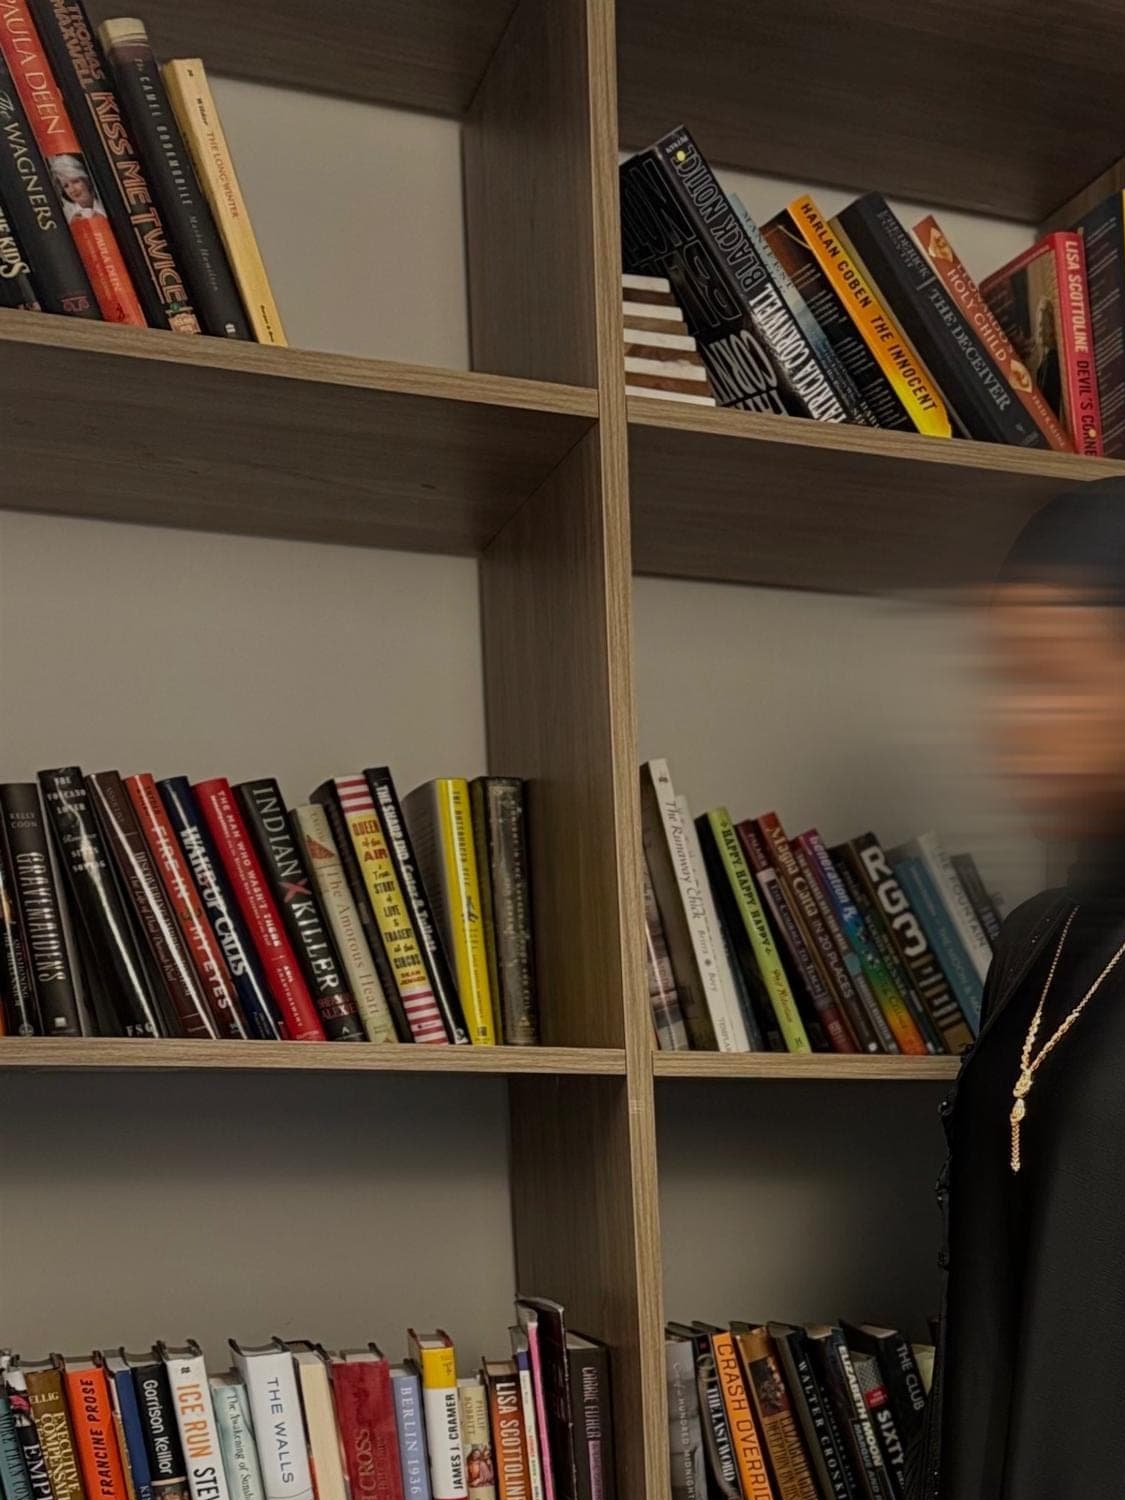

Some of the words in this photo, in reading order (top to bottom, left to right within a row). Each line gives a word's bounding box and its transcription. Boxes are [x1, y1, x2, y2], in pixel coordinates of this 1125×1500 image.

[65, 3, 103, 81] THOMAS
[0, 0, 39, 66] AULA
[24, 68, 64, 138] DEEN
[88, 85, 133, 157] KISS
[205, 131, 218, 151] THE
[2, 122, 57, 233] WAGNERS
[115, 157, 150, 209] ME
[211, 151, 227, 181] LONG
[220, 180, 239, 219] WINTER
[0, 234, 31, 279] KIDS
[132, 207, 188, 306] TWICE
[709, 216, 768, 291] BLACK
[1065, 240, 1079, 269] LISA
[745, 282, 812, 369] CORNWELL
[800, 202, 841, 258] HARLAN
[836, 259, 872, 308] COBEN
[869, 314, 893, 342] THE
[886, 342, 937, 414] INNOCENT
[945, 268, 976, 310] HOLY
[972, 311, 1007, 362] CHILD
[1067, 274, 1088, 353] SCOTTOLINE
[926, 287, 958, 328] THE
[950, 324, 1013, 411] DECEIVER
[1075, 360, 1093, 410] DEVIL'S
[1081, 414, 1097, 456] CORNE
[375, 784, 392, 805] THE
[662, 799, 680, 826] The
[352, 820, 380, 836] QUEEN
[380, 803, 404, 839] SHARP
[217, 790, 230, 812] THE
[226, 814, 240, 838] MAN
[235, 840, 250, 866] WHO
[246, 869, 266, 910] WASN'T
[263, 913, 281, 947] THERE
[363, 848, 388, 862] AIR
[392, 837, 411, 861] END
[666, 825, 695, 884] Runaway
[764, 823, 800, 876] Magna
[252, 783, 301, 878] INDIAN
[291, 897, 341, 992] KILLER
[327, 866, 351, 898] The
[684, 885, 703, 920] Chick
[16, 850, 65, 983] GRAVEMAIDENS
[151, 824, 179, 871] FIRE
[171, 875, 189, 899] IN
[189, 923, 210, 953] MY
[202, 958, 231, 1010] EYES
[384, 905, 402, 918] LOVE
[749, 909, 770, 946] HAPPY
[811, 919, 824, 933] IN
[946, 874, 989, 948] FOUNTAIN
[212, 914, 250, 977] CALLS
[337, 902, 373, 968] Amorous
[817, 933, 832, 950] 20
[393, 953, 421, 969] CIRCUS
[825, 950, 855, 998] PLACES
[357, 971, 386, 1015] Heart
[714, 1341, 749, 1412] CRASH
[893, 1343, 914, 1371] THE
[78, 1377, 101, 1423] PROSE
[142, 1378, 167, 1434] Garrison
[176, 1382, 205, 1414] ICE
[226, 1393, 239, 1411] The
[265, 1376, 283, 1414] THE
[473, 1399, 489, 1430] PHILIP
[495, 1381, 518, 1413] LISA
[797, 1360, 825, 1428] WALTER
[837, 1344, 869, 1419] ELIZABETH
[861, 1420, 882, 1466] MOON
[901, 1372, 928, 1411] CLUB
[183, 1418, 213, 1458] RUN
[227, 1413, 247, 1461] Awakening
[399, 1386, 418, 1452] BERLIN
[445, 1394, 458, 1439] CRAMER
[460, 1396, 479, 1435] BOBBITT
[677, 1398, 688, 1444] HUNDRED
[711, 1412, 730, 1445] LAST
[872, 1408, 908, 1466] SIXTY
[3, 1446, 24, 1477] THAN
[53, 1411, 79, 1492] EXECUTIVE
[88, 1428, 115, 1497] FRANCINE
[151, 1435, 176, 1475] Keillor
[237, 1461, 249, 1471] of
[271, 1421, 295, 1484] WALLS
[350, 1428, 376, 1491] CROSS
[717, 1444, 737, 1482] WORD
[764, 1420, 790, 1470] DECEPTION
[778, 1415, 808, 1476] ELIZABETH
[853, 1422, 873, 1468] MARQUE
[866, 1469, 881, 1492] AND
[406, 1458, 422, 1495] 1936
[450, 1454, 463, 1489] JAMES
